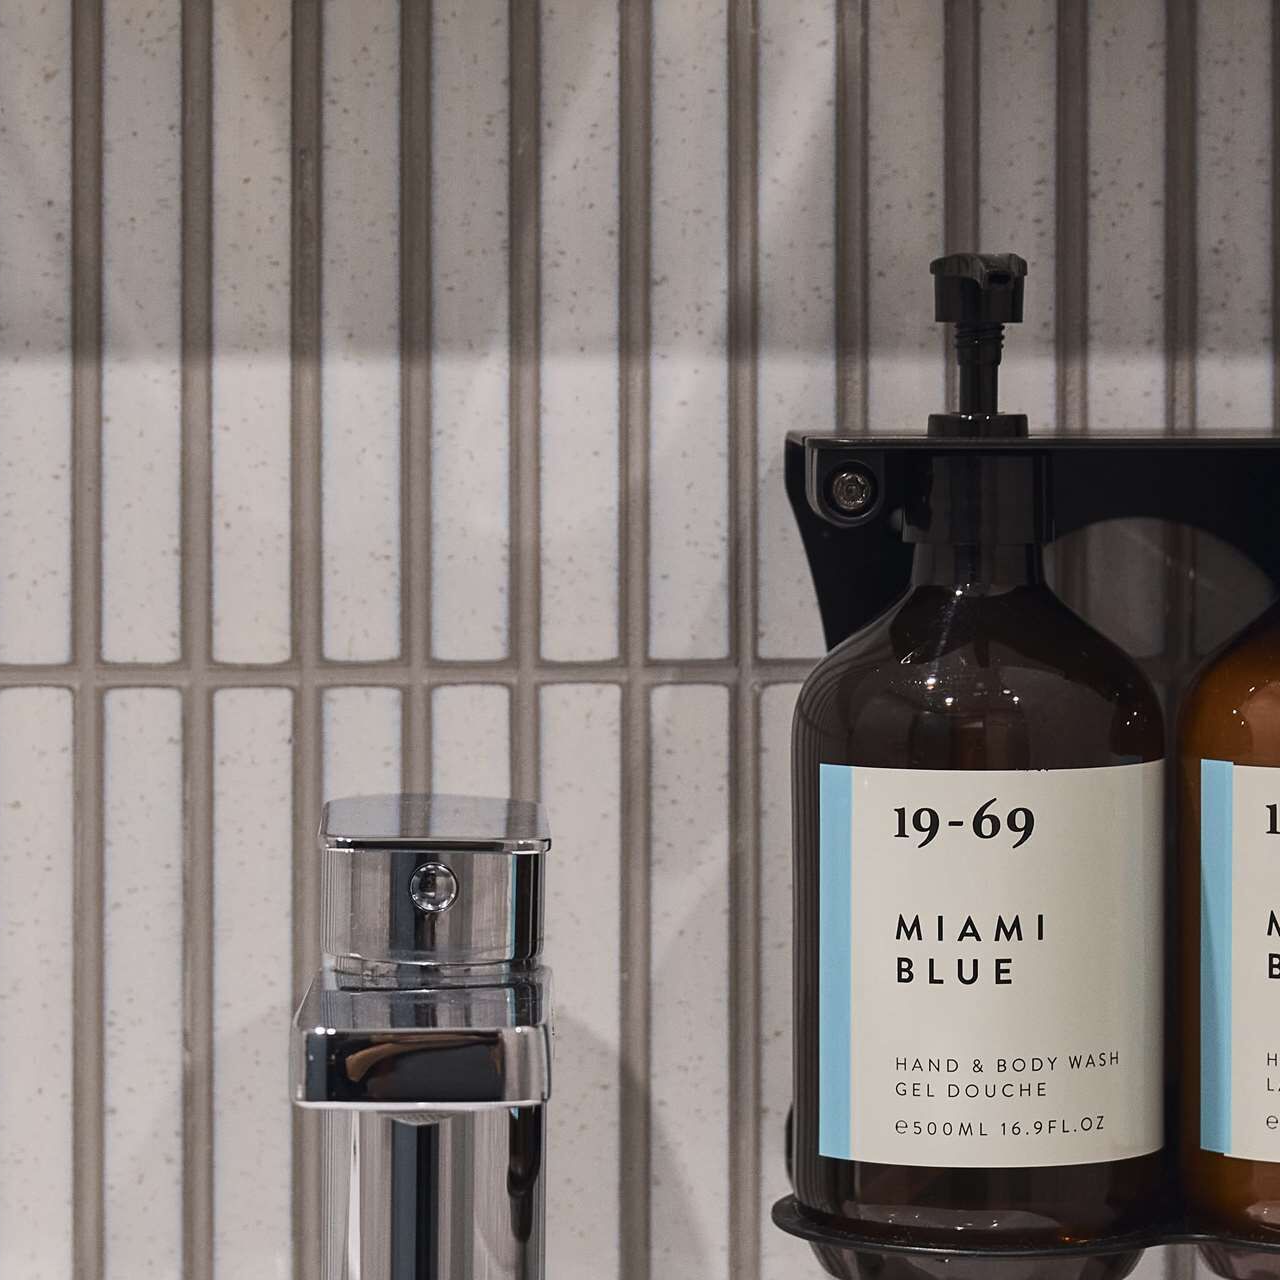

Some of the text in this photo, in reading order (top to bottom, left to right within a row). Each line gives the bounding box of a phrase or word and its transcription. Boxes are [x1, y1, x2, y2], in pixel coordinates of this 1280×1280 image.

[893, 797, 1035, 849] 19-69
[895, 913, 1044, 942] MIAMI
[896, 956, 1013, 986] BLUE
[895, 1051, 1119, 1073] HAND & BODY WASH
[895, 1081, 1047, 1098] GEL DOUCHE
